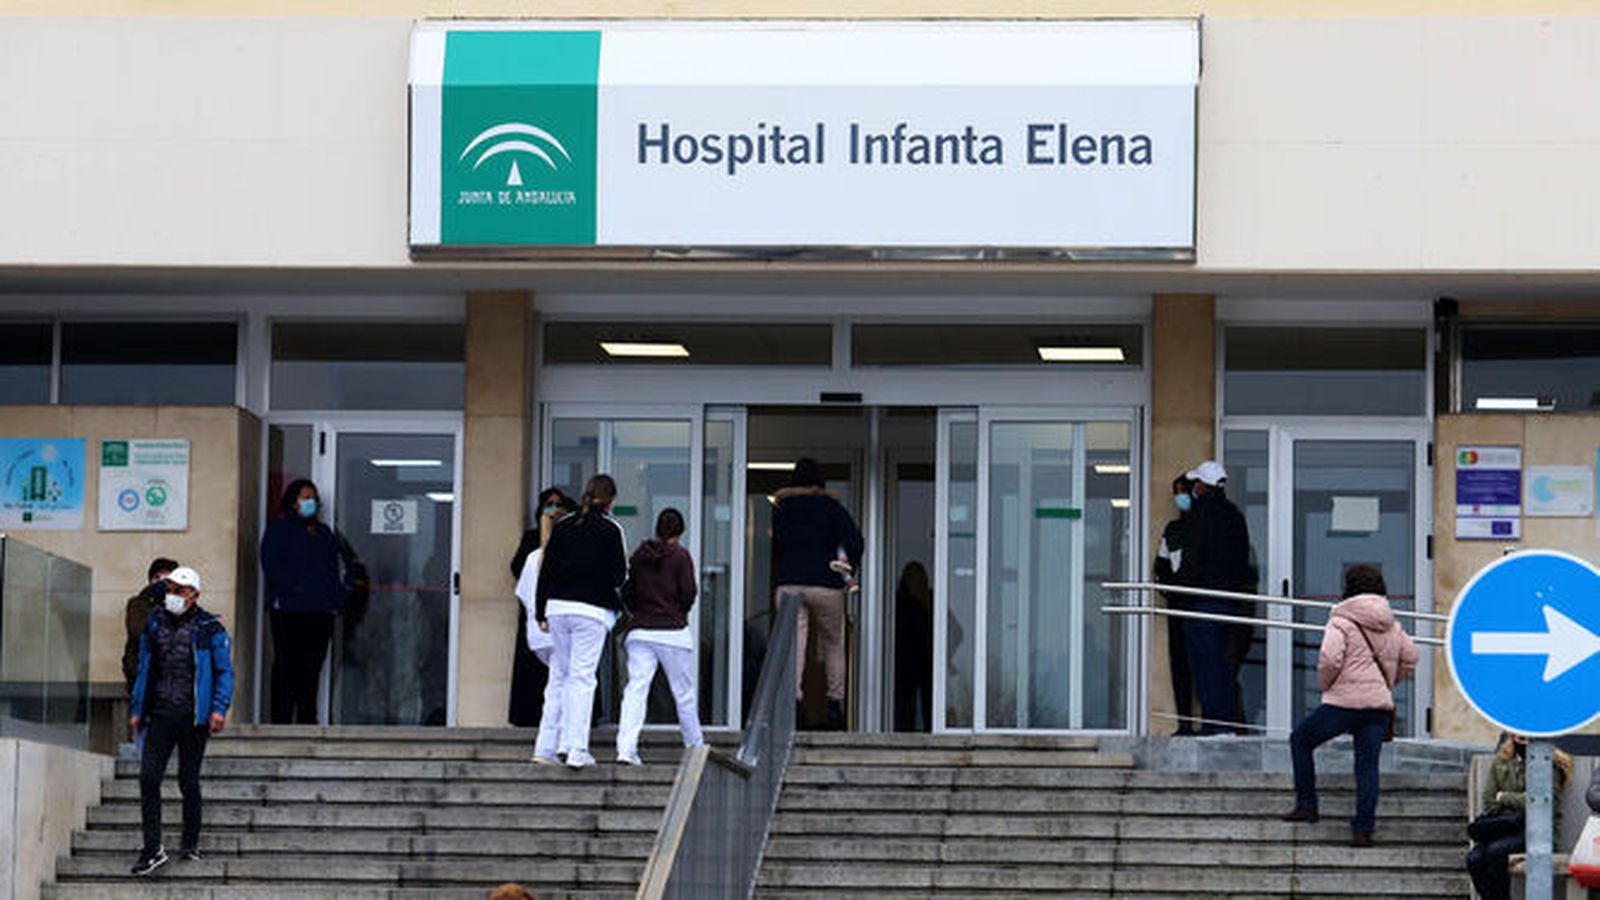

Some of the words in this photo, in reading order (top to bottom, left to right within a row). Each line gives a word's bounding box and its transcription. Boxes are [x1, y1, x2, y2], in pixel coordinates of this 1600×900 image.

[638, 122, 825, 175] Hospital
[850, 122, 1003, 165] Infanta
[1027, 122, 1152, 165] Elena
[498, 190, 512, 205] DE
